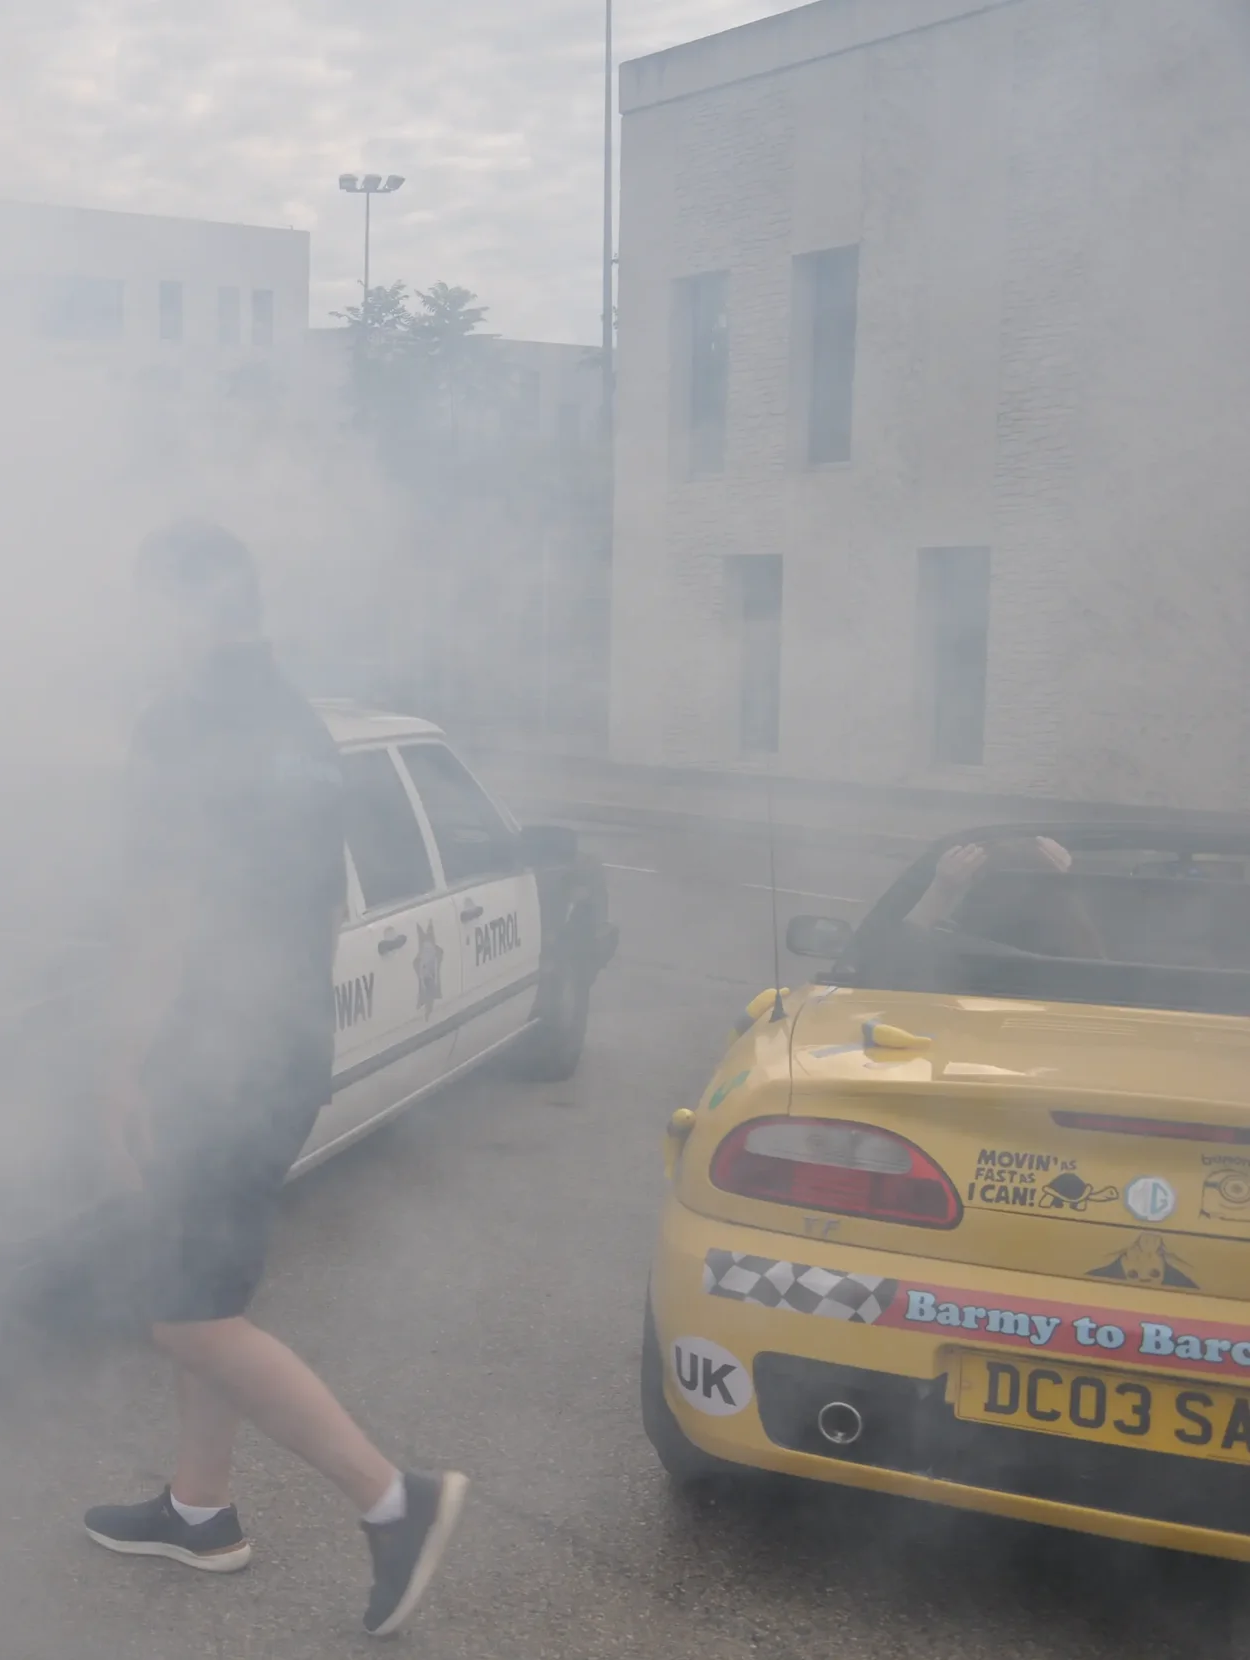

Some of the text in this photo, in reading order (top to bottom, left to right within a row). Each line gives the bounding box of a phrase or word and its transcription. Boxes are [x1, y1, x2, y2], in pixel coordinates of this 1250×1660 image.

[475, 911, 521, 967] PATROL
[334, 972, 374, 1032] WAY
[975, 1167, 1036, 1184] FAST AS
[977, 1149, 1077, 1171] MOVIN' AS
[968, 1182, 1036, 1207] I CAN!
[905, 1289, 1061, 1346] Barmy
[1072, 1315, 1125, 1349] to
[675, 1344, 738, 1407] UK
